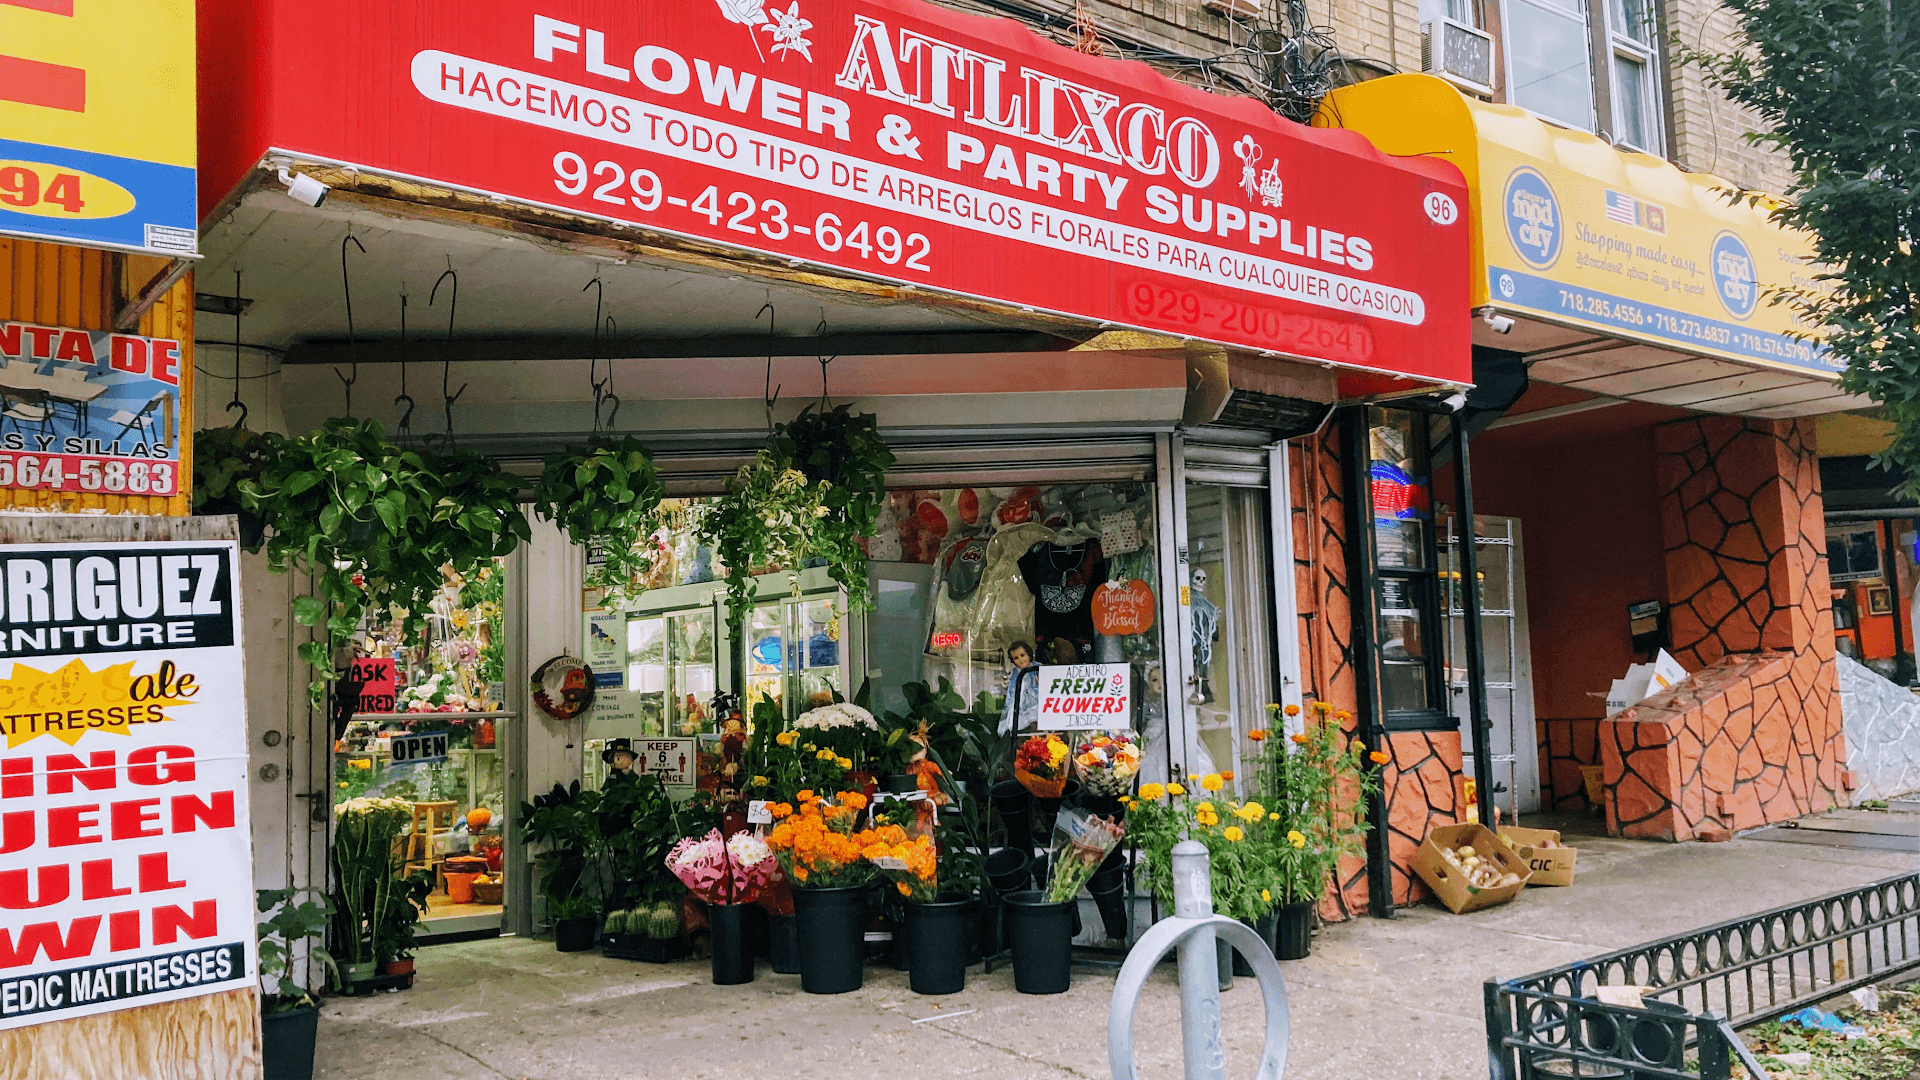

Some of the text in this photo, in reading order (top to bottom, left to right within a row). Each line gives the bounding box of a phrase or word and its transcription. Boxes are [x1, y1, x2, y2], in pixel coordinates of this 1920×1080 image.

[836, 14, 1220, 189] ATLIXCO
[533, 13, 1374, 271] FLOWER & PARTY SUPPLIES
[0, 166, 85, 213] 94
[440, 62, 1413, 317] HACEMOS TODO TIPO DE ARREGLOS FLORALES PARA CUALQUIER OCASION
[552, 150, 931, 272] 929-423-6492
[1429, 196, 1452, 222] 96
[1512, 189, 1555, 228] food
[1519, 221, 1553, 258] city
[1575, 221, 1633, 261] Shopping
[1636, 244, 1668, 265] made
[1717, 249, 1752, 283] food
[1500, 278, 1513, 293] 98
[1133, 284, 1368, 357] 929-200-2641
[1559, 289, 1644, 326] 718.285.4556
[1655, 313, 1731, 345] 718.273.6837
[1741, 333, 1810, 362] 718.576.5790
[110, 334, 178, 386] DE
[34, 434, 55, 452] Y
[64, 438, 169, 459] SILLAS
[0, 454, 172, 494] 564-5883
[0, 555, 222, 623] RIGUEZ
[1098, 586, 1148, 608] Thankful
[1102, 611, 1140, 632] Blessed
[351, 663, 388, 683] ASK
[1049, 677, 1107, 695] FRESH
[1065, 664, 1108, 679] ADENTRO
[0, 703, 164, 735] TTRESSES
[1042, 696, 1127, 715] FLOWERS
[1065, 714, 1104, 728] INSIDE
[392, 736, 447, 762] OPEN
[647, 742, 678, 751] KEEP
[658, 751, 667, 763] 6
[1529, 858, 1552, 872] CIC
[0, 948, 232, 1014] EDIC MATTRESSES
